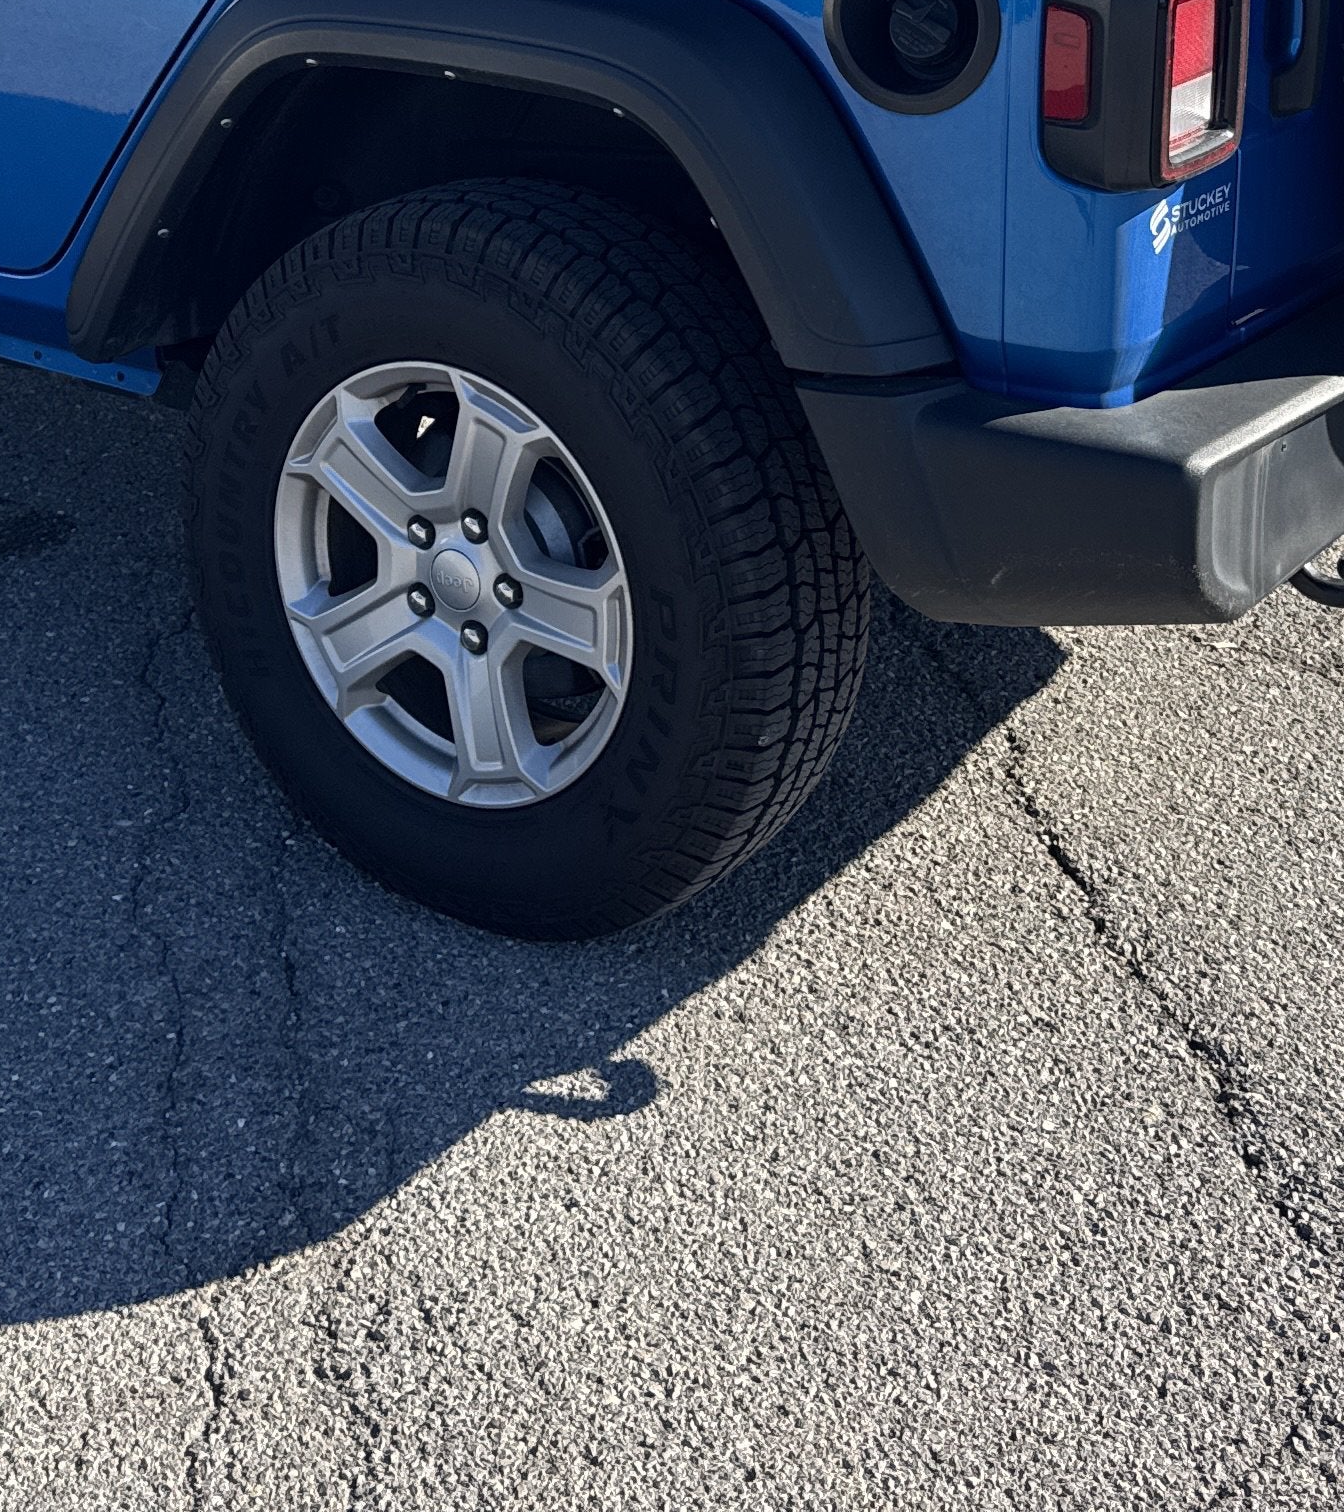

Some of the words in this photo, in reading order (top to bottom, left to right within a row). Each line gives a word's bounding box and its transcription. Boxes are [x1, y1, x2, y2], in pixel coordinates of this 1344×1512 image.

[1170, 182, 1232, 223] STUCKEY
[1170, 200, 1231, 236] AUTOMOTIVE
[436, 570, 474, 594] Jeep
